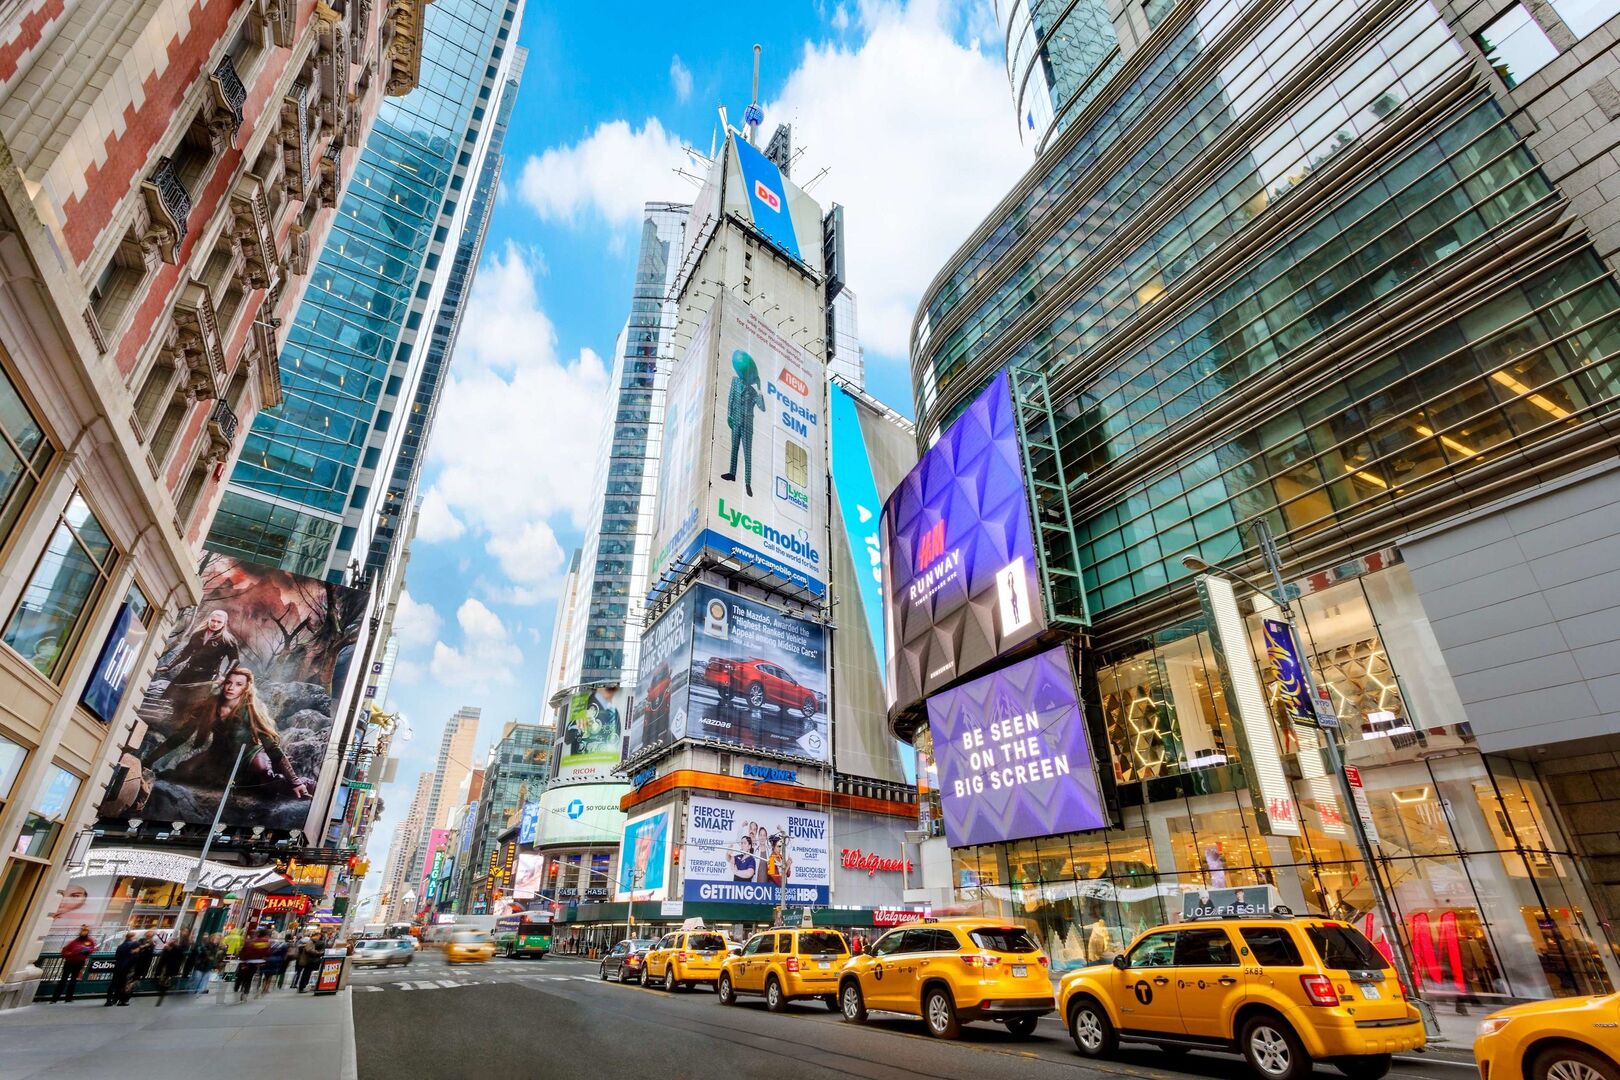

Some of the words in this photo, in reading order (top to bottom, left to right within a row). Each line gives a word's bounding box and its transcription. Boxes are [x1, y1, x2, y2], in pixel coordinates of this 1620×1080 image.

[785, 370, 806, 394] new
[767, 381, 817, 425] Prepaid
[782, 412, 808, 437] SIM
[788, 484, 808, 502] Lyca
[788, 495, 808, 509] mobile
[719, 498, 819, 563] Lycamobile
[764, 541, 775, 550] Call
[776, 547, 785, 556] the
[786, 553, 801, 563] world
[910, 548, 960, 600] RUNWAY
[643, 630, 655, 658] THE
[655, 602, 684, 646] OWNERS
[733, 605, 744, 616] The
[746, 609, 772, 625] Mazda6,
[773, 619, 798, 633] Awarded
[800, 627, 809, 637] the
[732, 626, 754, 639] Appeal
[756, 634, 776, 648] among
[778, 640, 800, 654] Midsize
[763, 625, 784, 639] Ranked
[786, 632, 807, 646] Vehicle
[373, 664, 380, 672] C
[963, 729, 984, 750] BE
[991, 711, 1039, 741] SEEN
[970, 749, 994, 770] ON
[1001, 736, 1040, 762] THE
[572, 767, 596, 775] RICOH
[743, 764, 768, 777] DOW
[765, 767, 797, 783] JONES
[954, 775, 983, 797] BIG
[991, 754, 1070, 789] SCREEN
[694, 816, 734, 831] SMART
[789, 826, 824, 839] FUNNY
[842, 848, 913, 876] Walgreens
[428, 852, 442, 897] REGAL
[797, 888, 818, 901] HBO
[874, 910, 920, 925] Walgreens
[1187, 907, 1212, 917] JOE
[1218, 904, 1266, 915] FRESH
